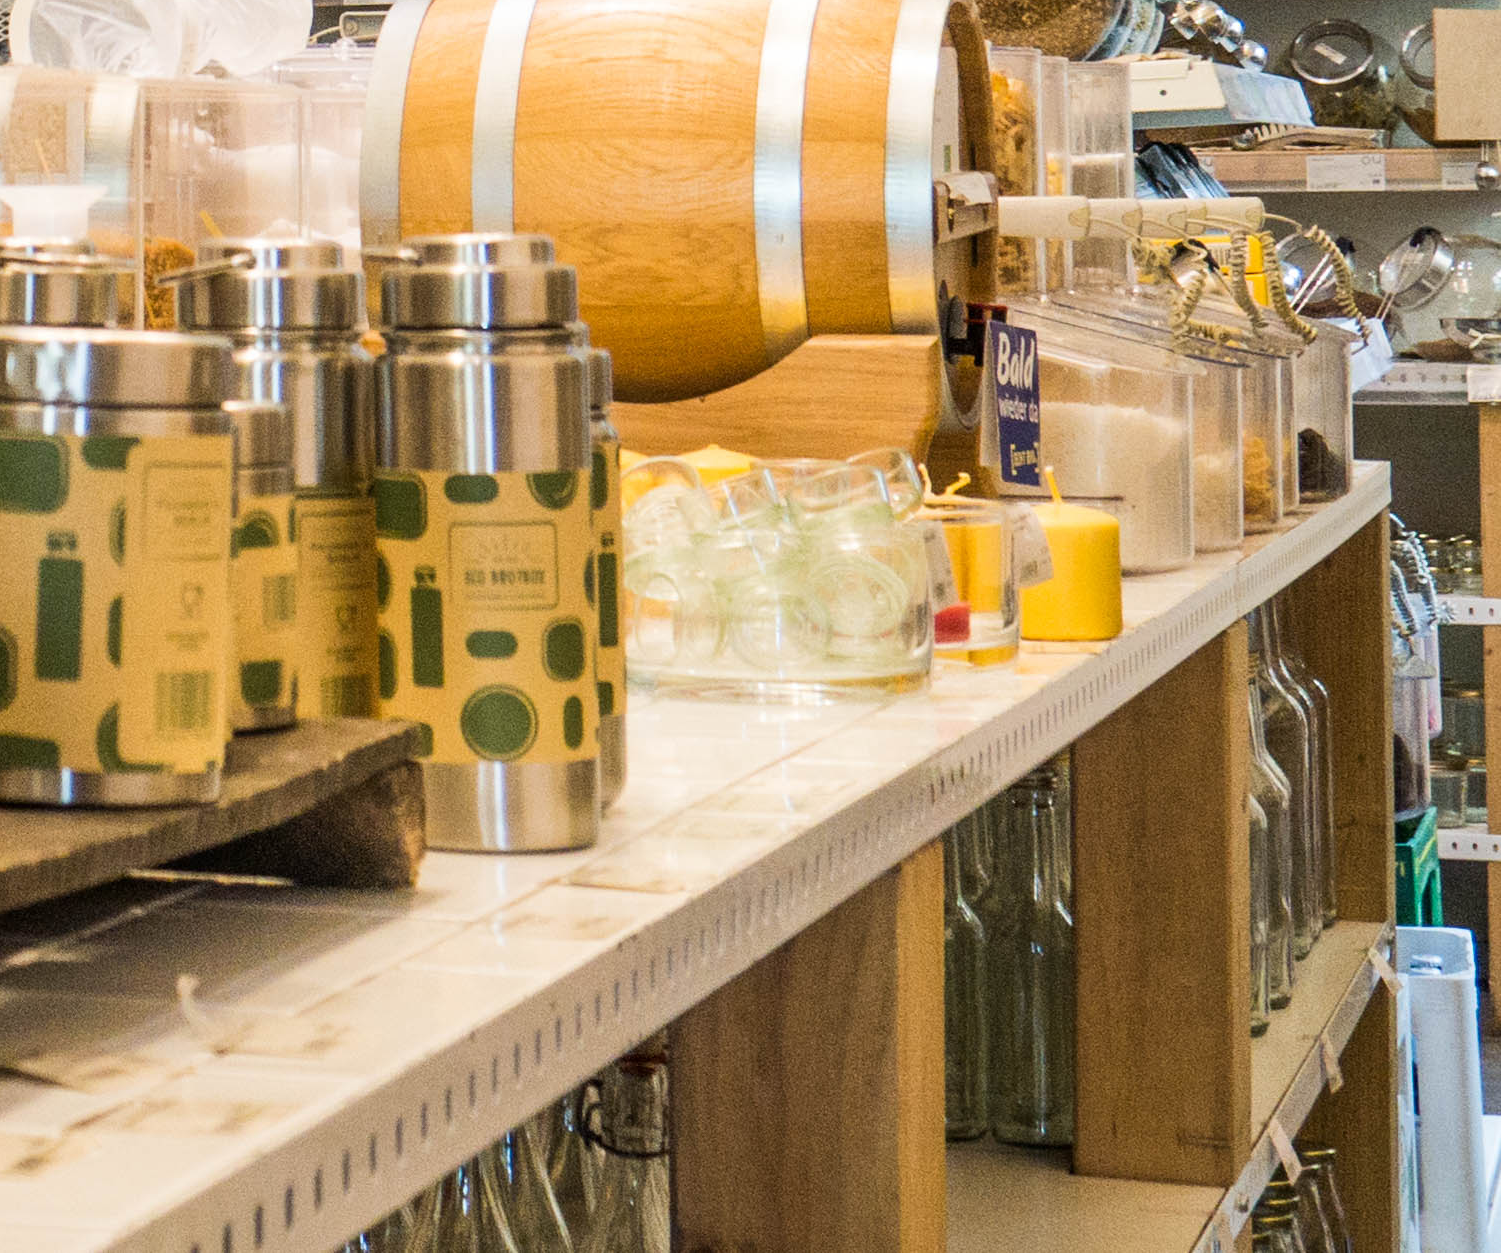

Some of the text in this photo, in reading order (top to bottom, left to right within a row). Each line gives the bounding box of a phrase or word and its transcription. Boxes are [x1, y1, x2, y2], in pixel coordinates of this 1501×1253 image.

[998, 332, 1036, 393] Bald
[998, 394, 1039, 424] wieder da
